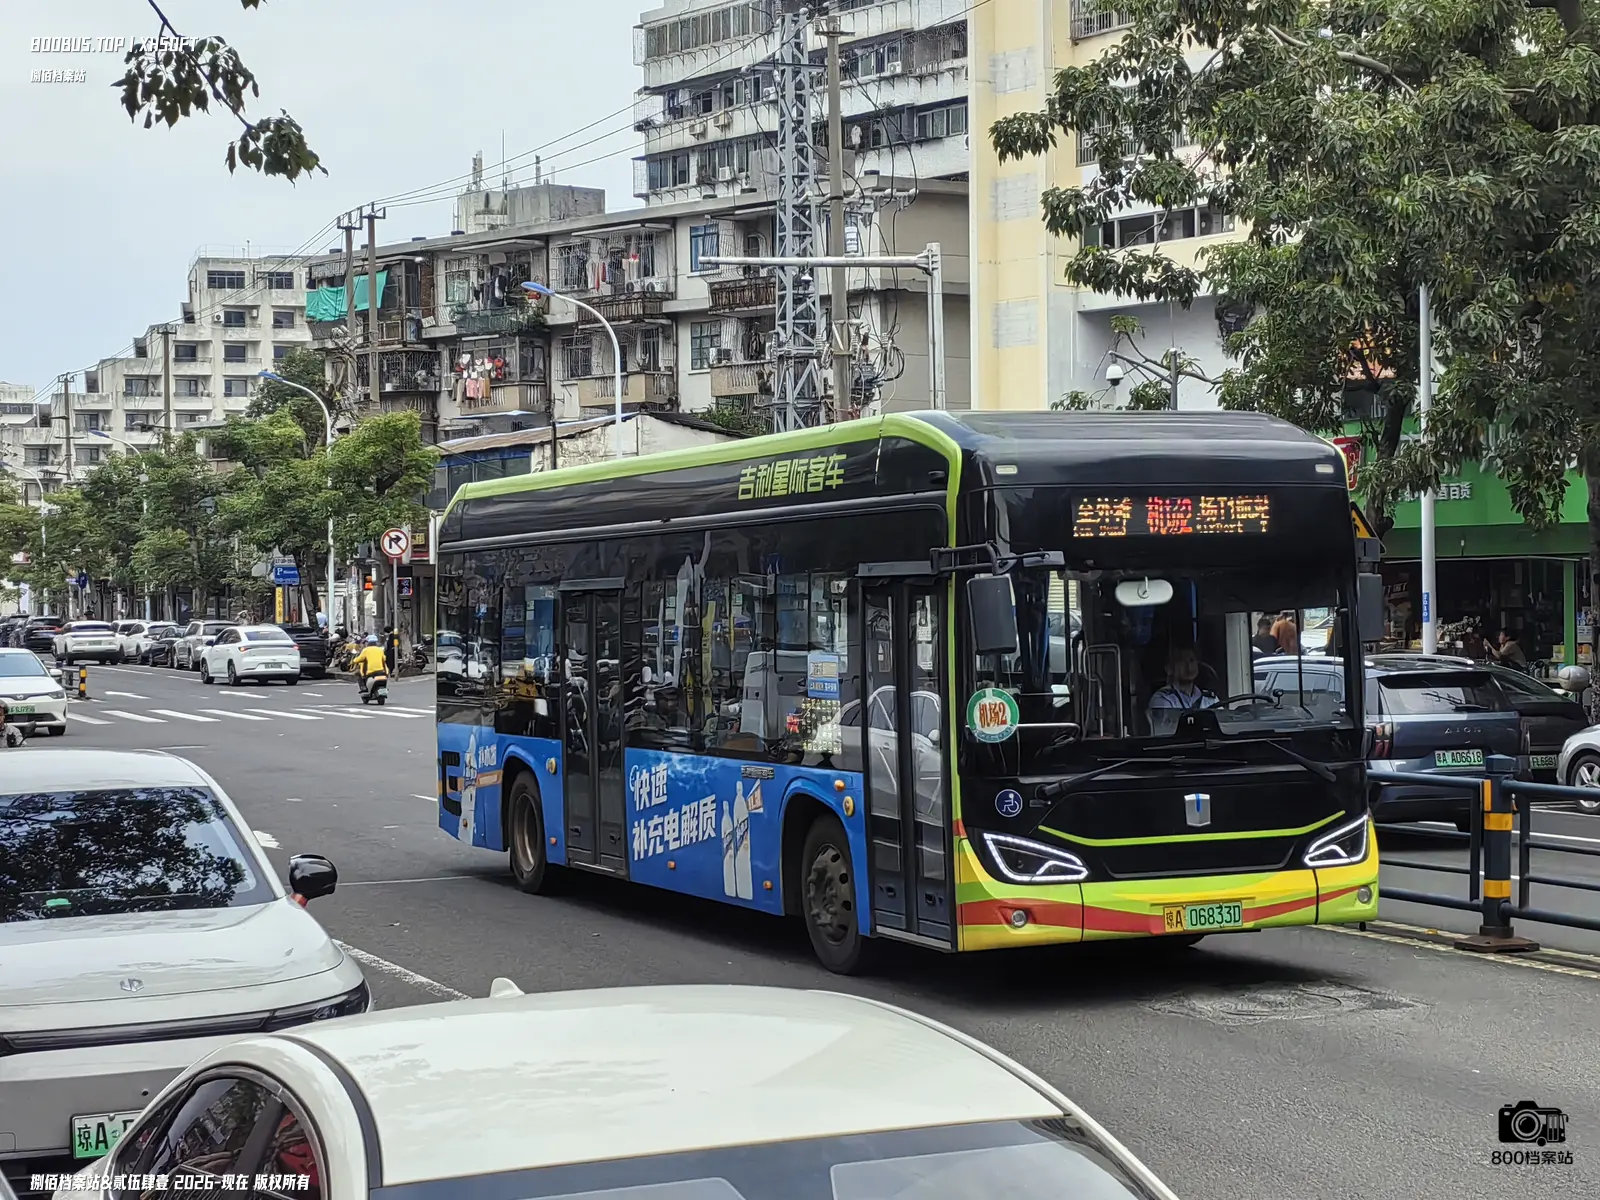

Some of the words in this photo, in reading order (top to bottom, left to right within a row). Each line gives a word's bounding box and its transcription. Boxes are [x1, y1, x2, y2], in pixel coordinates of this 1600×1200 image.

[737, 453, 847, 500] 吉利星际客车
[633, 762, 669, 812] 快速
[632, 793, 717, 862] 补充电解质
[1189, 904, 1241, 927] 06833D
